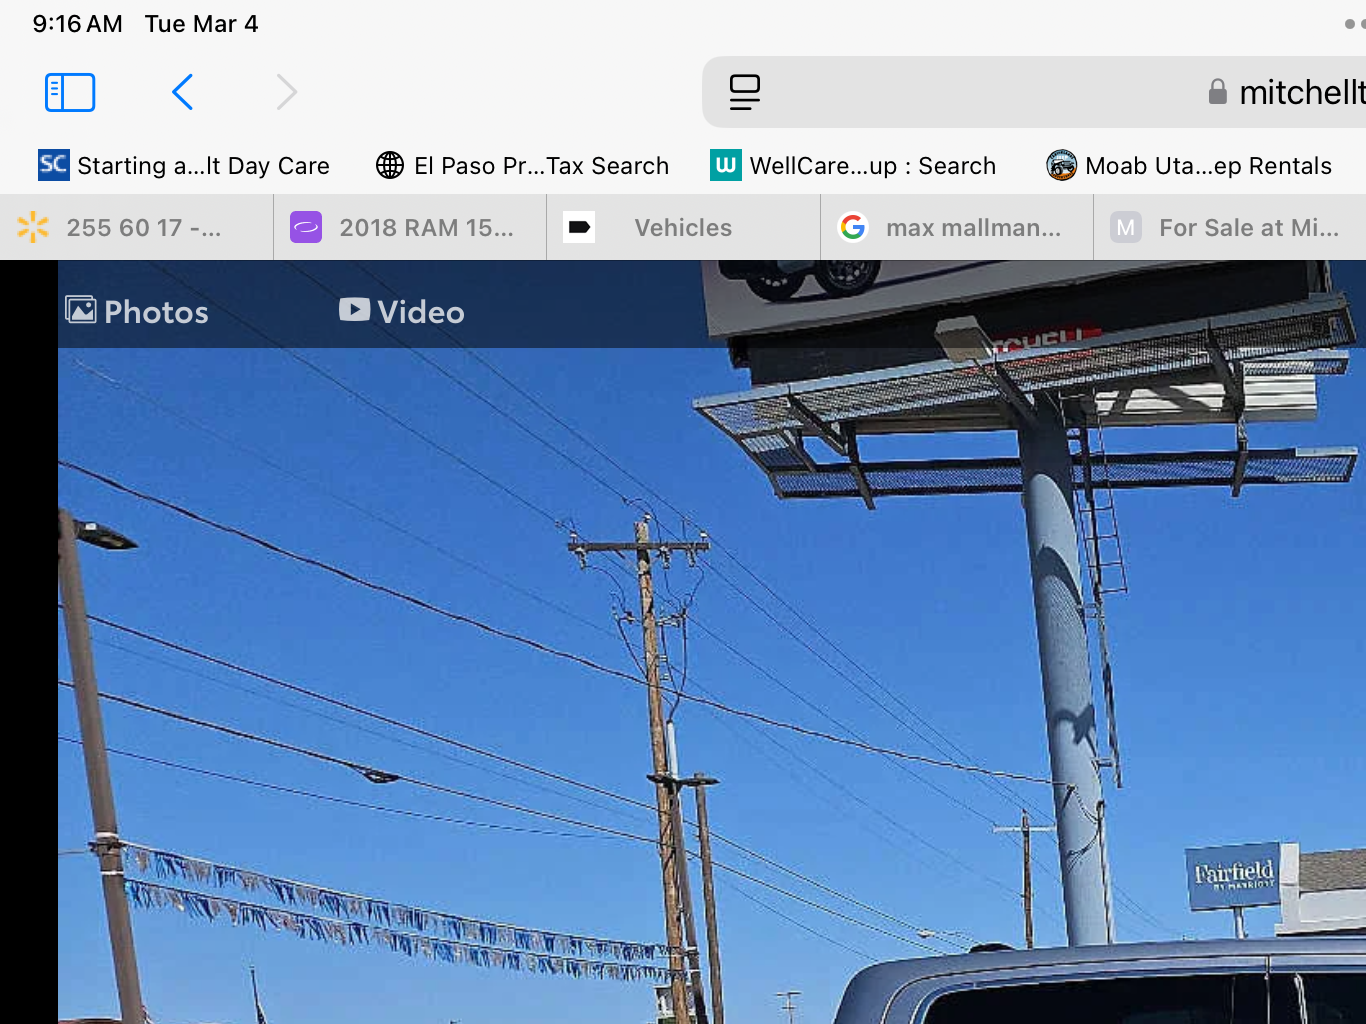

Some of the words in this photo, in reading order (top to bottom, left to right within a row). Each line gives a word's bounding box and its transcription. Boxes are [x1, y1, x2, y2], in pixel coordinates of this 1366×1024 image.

[33, 14, 81, 33] 9:16
[86, 15, 121, 32] AM
[145, 15, 185, 33] Tue
[194, 15, 237, 33] Mar
[244, 15, 258, 32] 4
[40, 155, 66, 173] SC
[78, 156, 165, 179] Starting
[229, 157, 270, 179] Day
[279, 156, 329, 175] Care
[416, 156, 432, 174] El
[443, 157, 495, 174] Paso
[592, 156, 668, 175] Search
[919, 156, 995, 175] Search
[1087, 156, 1147, 175] Moab
[1250, 156, 1332, 174] Rentals
[68, 219, 111, 236] 255
[120, 219, 149, 236] 60
[158, 219, 182, 236] 17
[341, 219, 396, 236] 2018
[406, 219, 457, 236] RAM
[635, 218, 732, 236] Vehicles
[888, 223, 934, 236] max
[1117, 219, 1135, 236] M
[1161, 219, 1197, 236] For
[1206, 218, 1253, 236] Sale
[1262, 220, 1283, 236] at
[106, 299, 208, 323] Photos
[378, 299, 464, 323] Video
[1195, 859, 1275, 884] Fairfield
